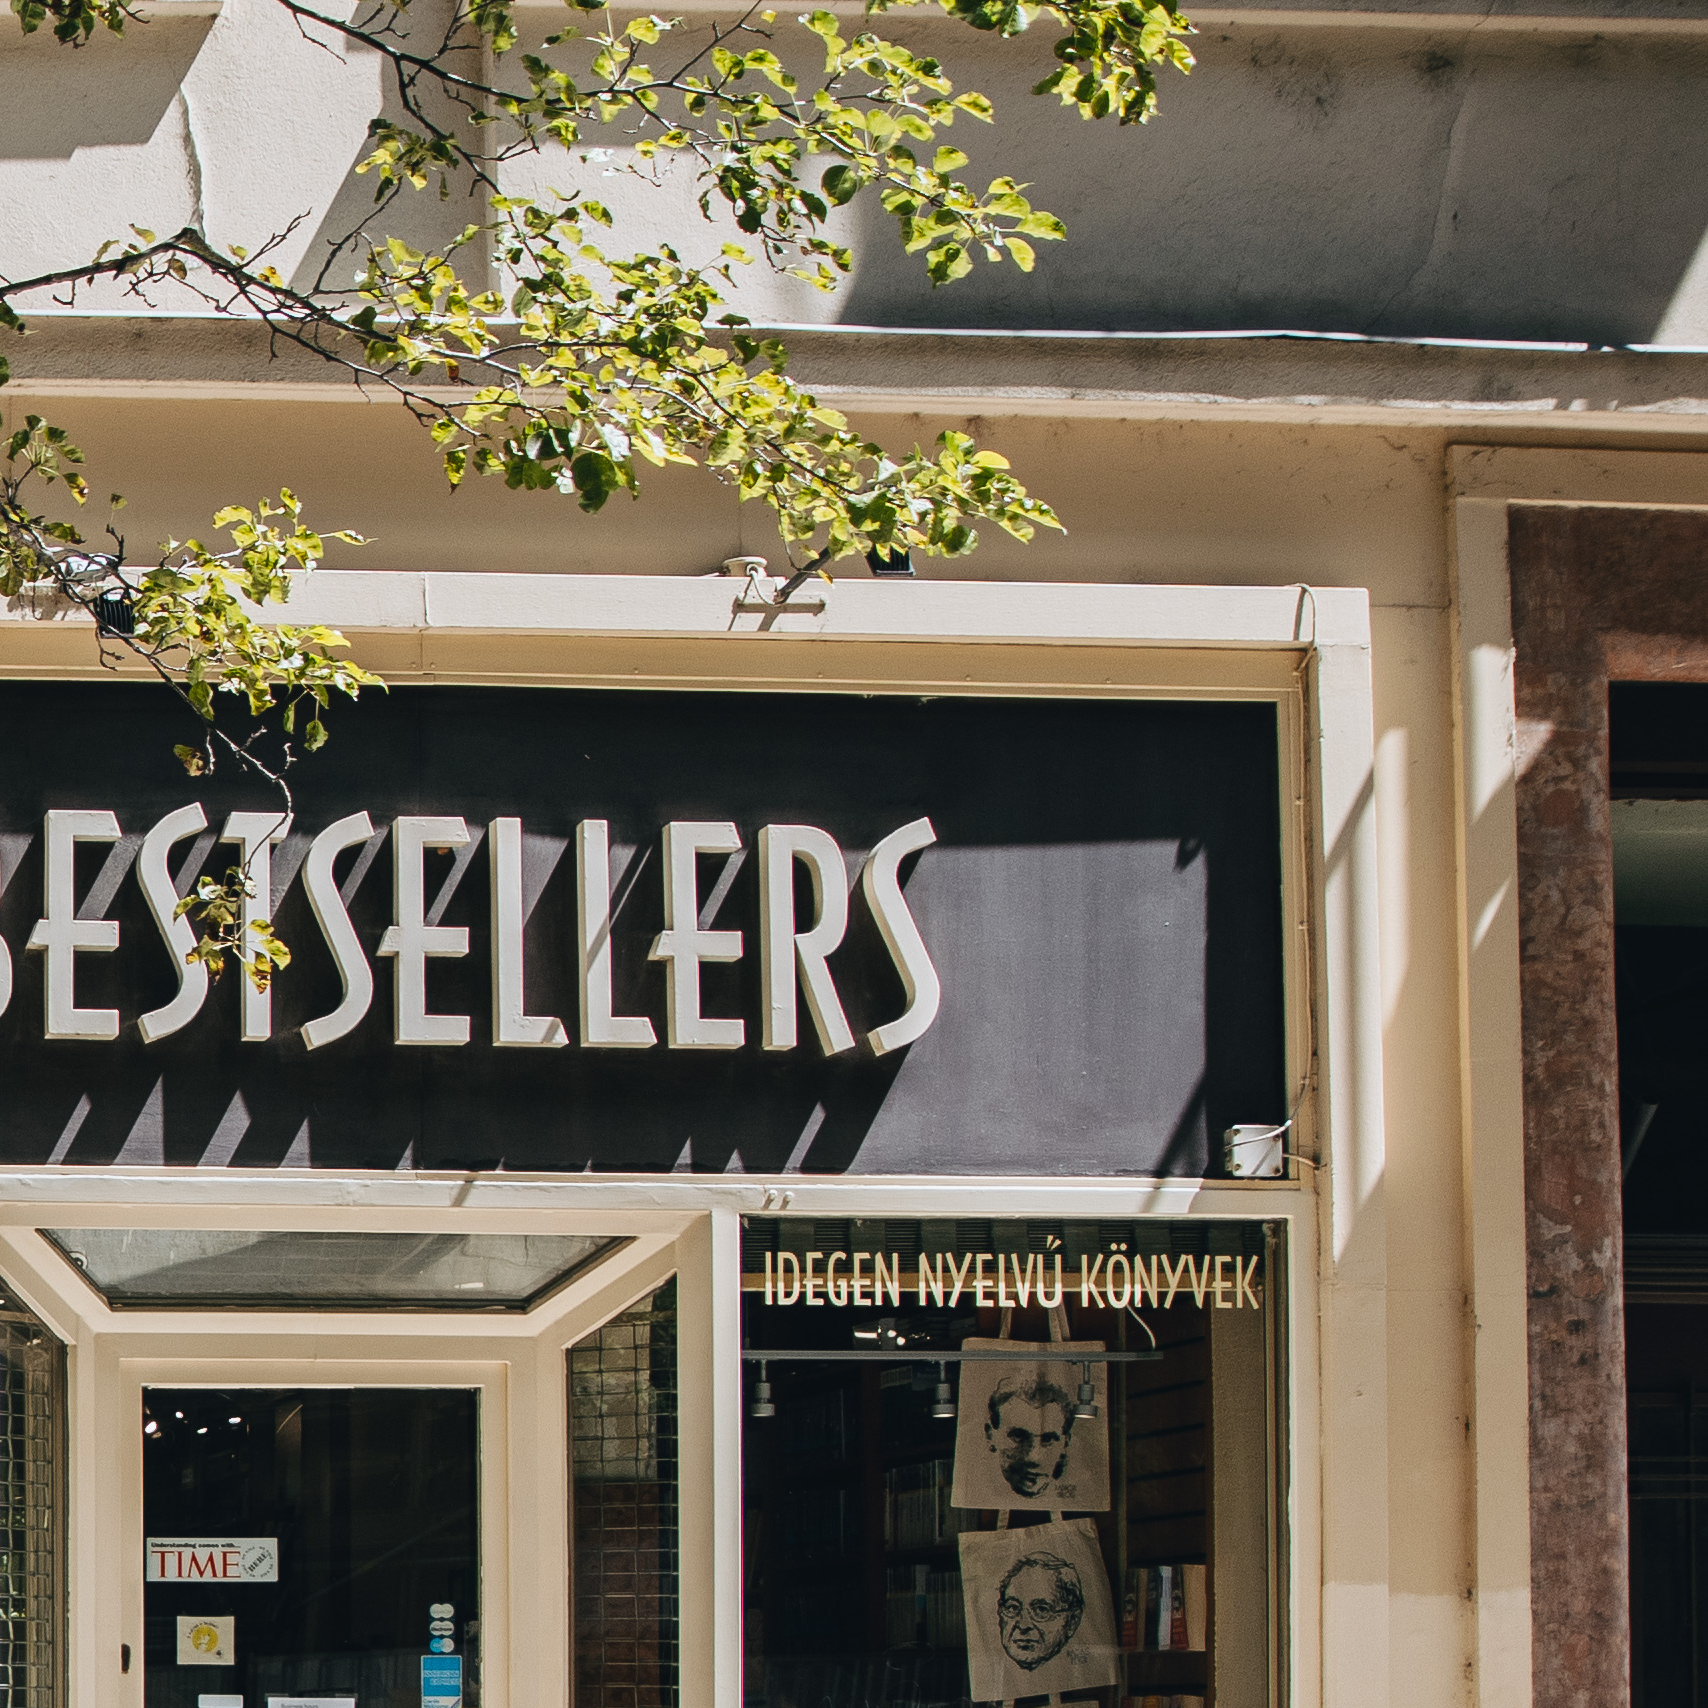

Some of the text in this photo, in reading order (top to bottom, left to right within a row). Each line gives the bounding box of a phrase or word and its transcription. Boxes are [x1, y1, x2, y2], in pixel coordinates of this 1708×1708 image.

[764, 1236, 1260, 1311] IDEGEN NYELVŰ KÖNYVEK
[151, 1550, 242, 1579] TIME
